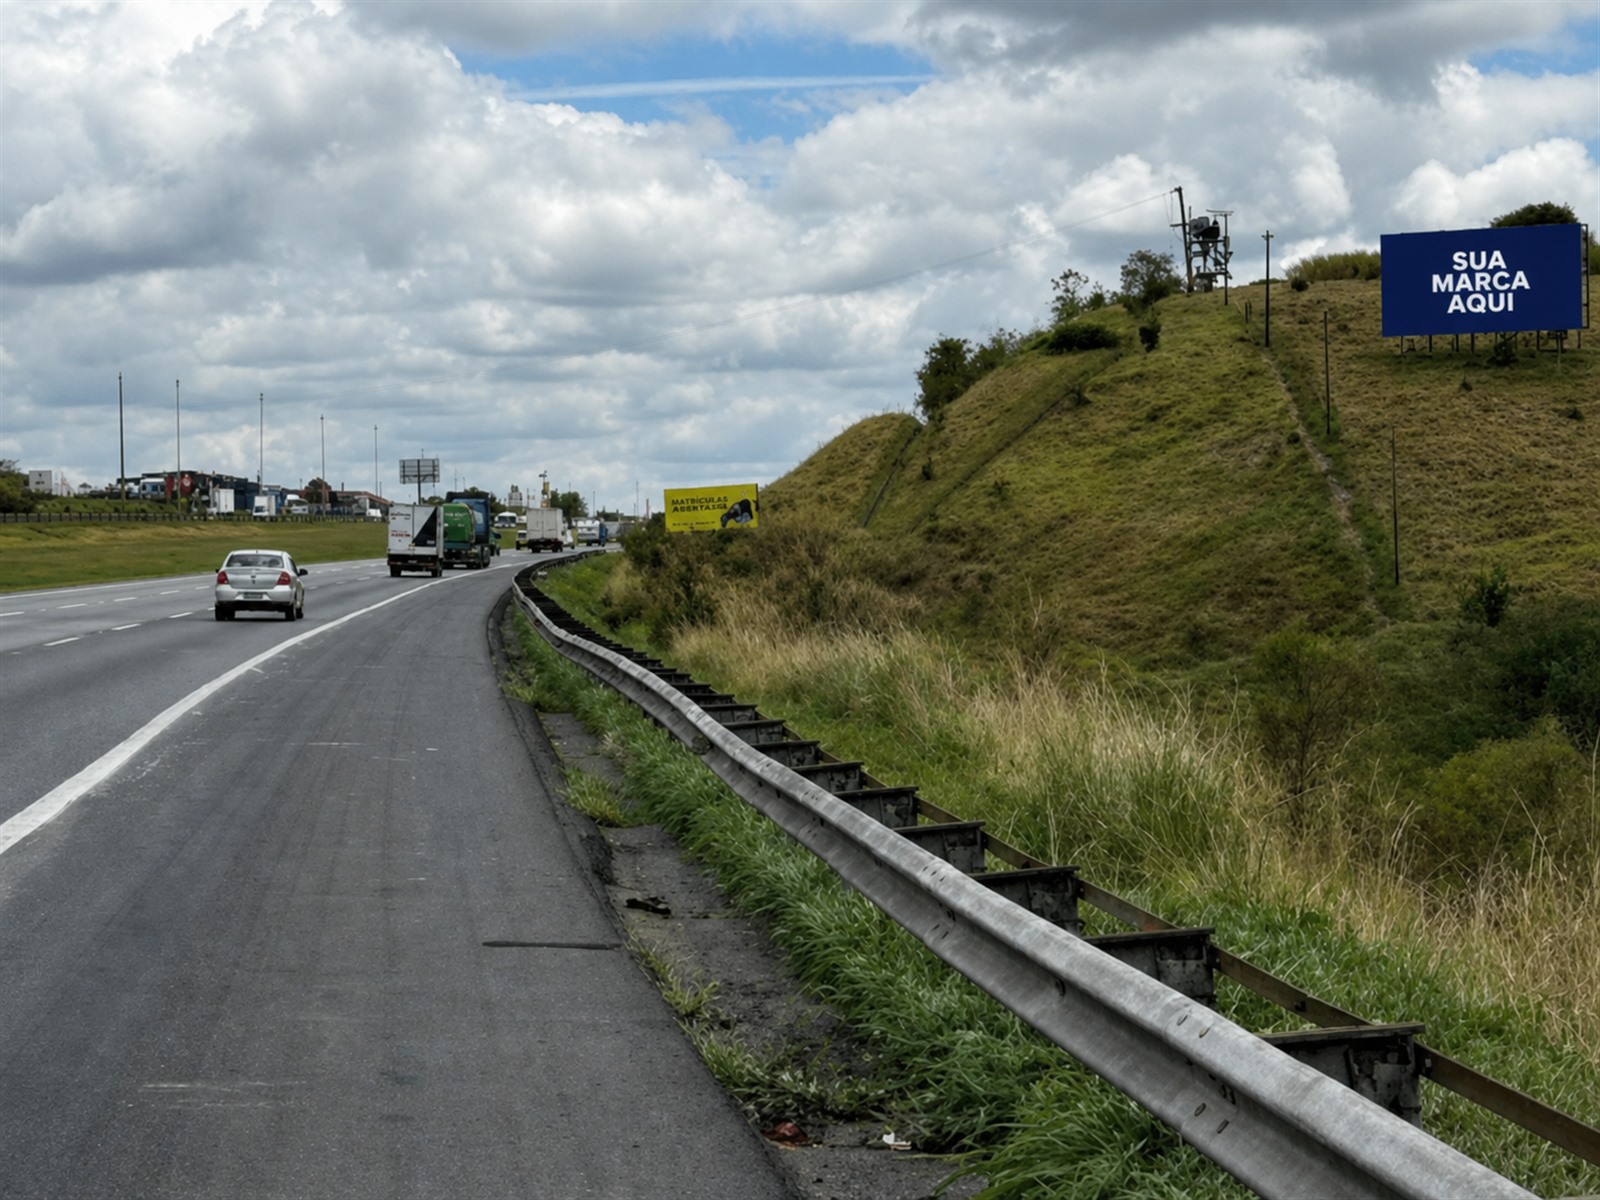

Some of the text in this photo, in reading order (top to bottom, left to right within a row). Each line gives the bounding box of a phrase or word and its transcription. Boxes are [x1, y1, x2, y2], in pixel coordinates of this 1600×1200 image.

[1452, 250, 1507, 271] SUA
[1432, 270, 1531, 293] MARCA
[1447, 292, 1514, 314] AQUI
